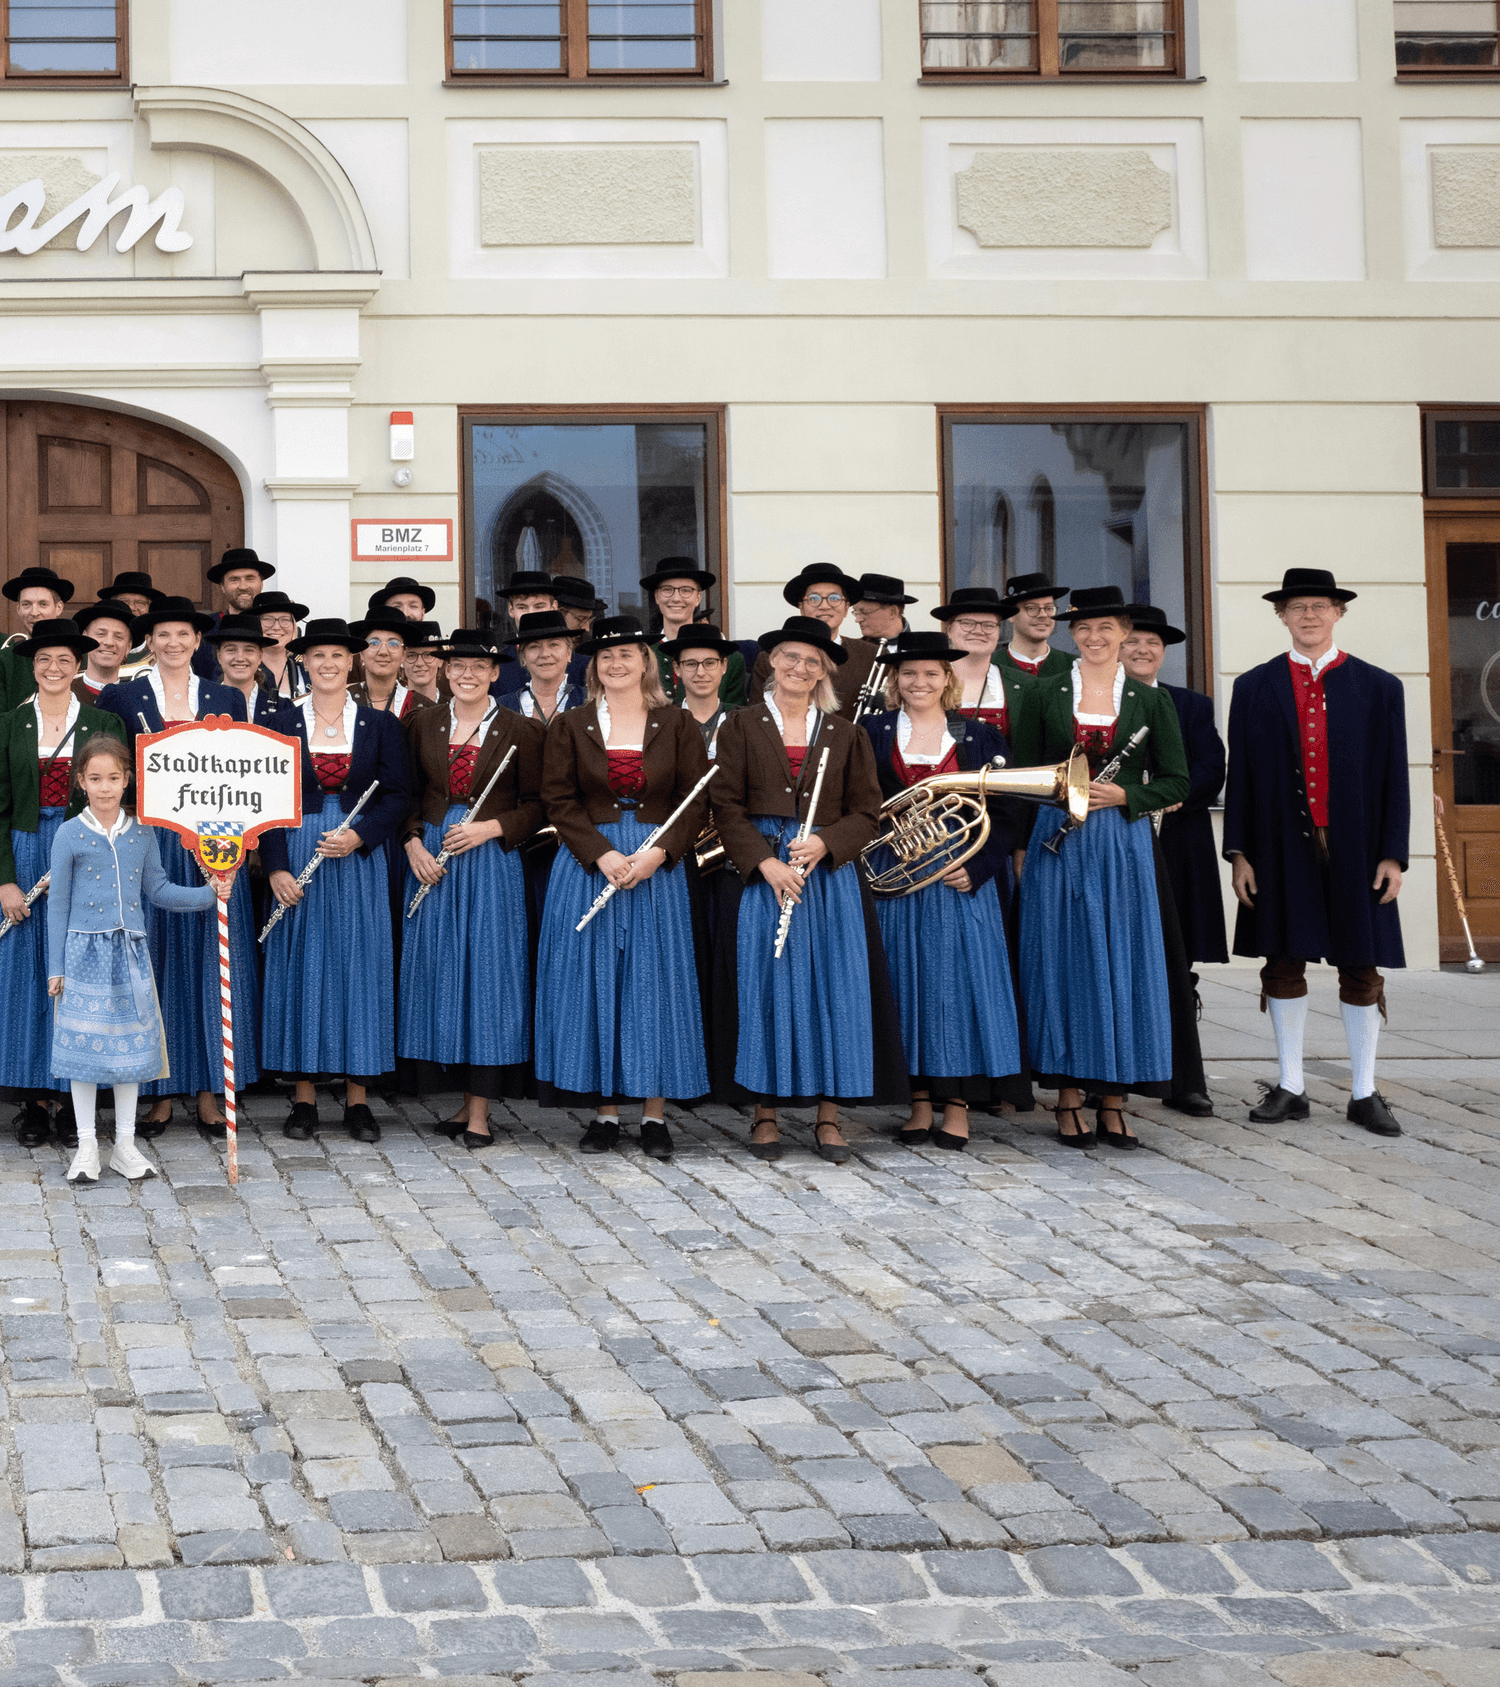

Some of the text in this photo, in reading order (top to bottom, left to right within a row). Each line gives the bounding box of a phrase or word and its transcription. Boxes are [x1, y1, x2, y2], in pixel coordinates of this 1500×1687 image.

[381, 528, 423, 543] BMZ
[375, 545, 422, 553] Marienplatz
[146, 751, 290, 779] Stadtkapelle
